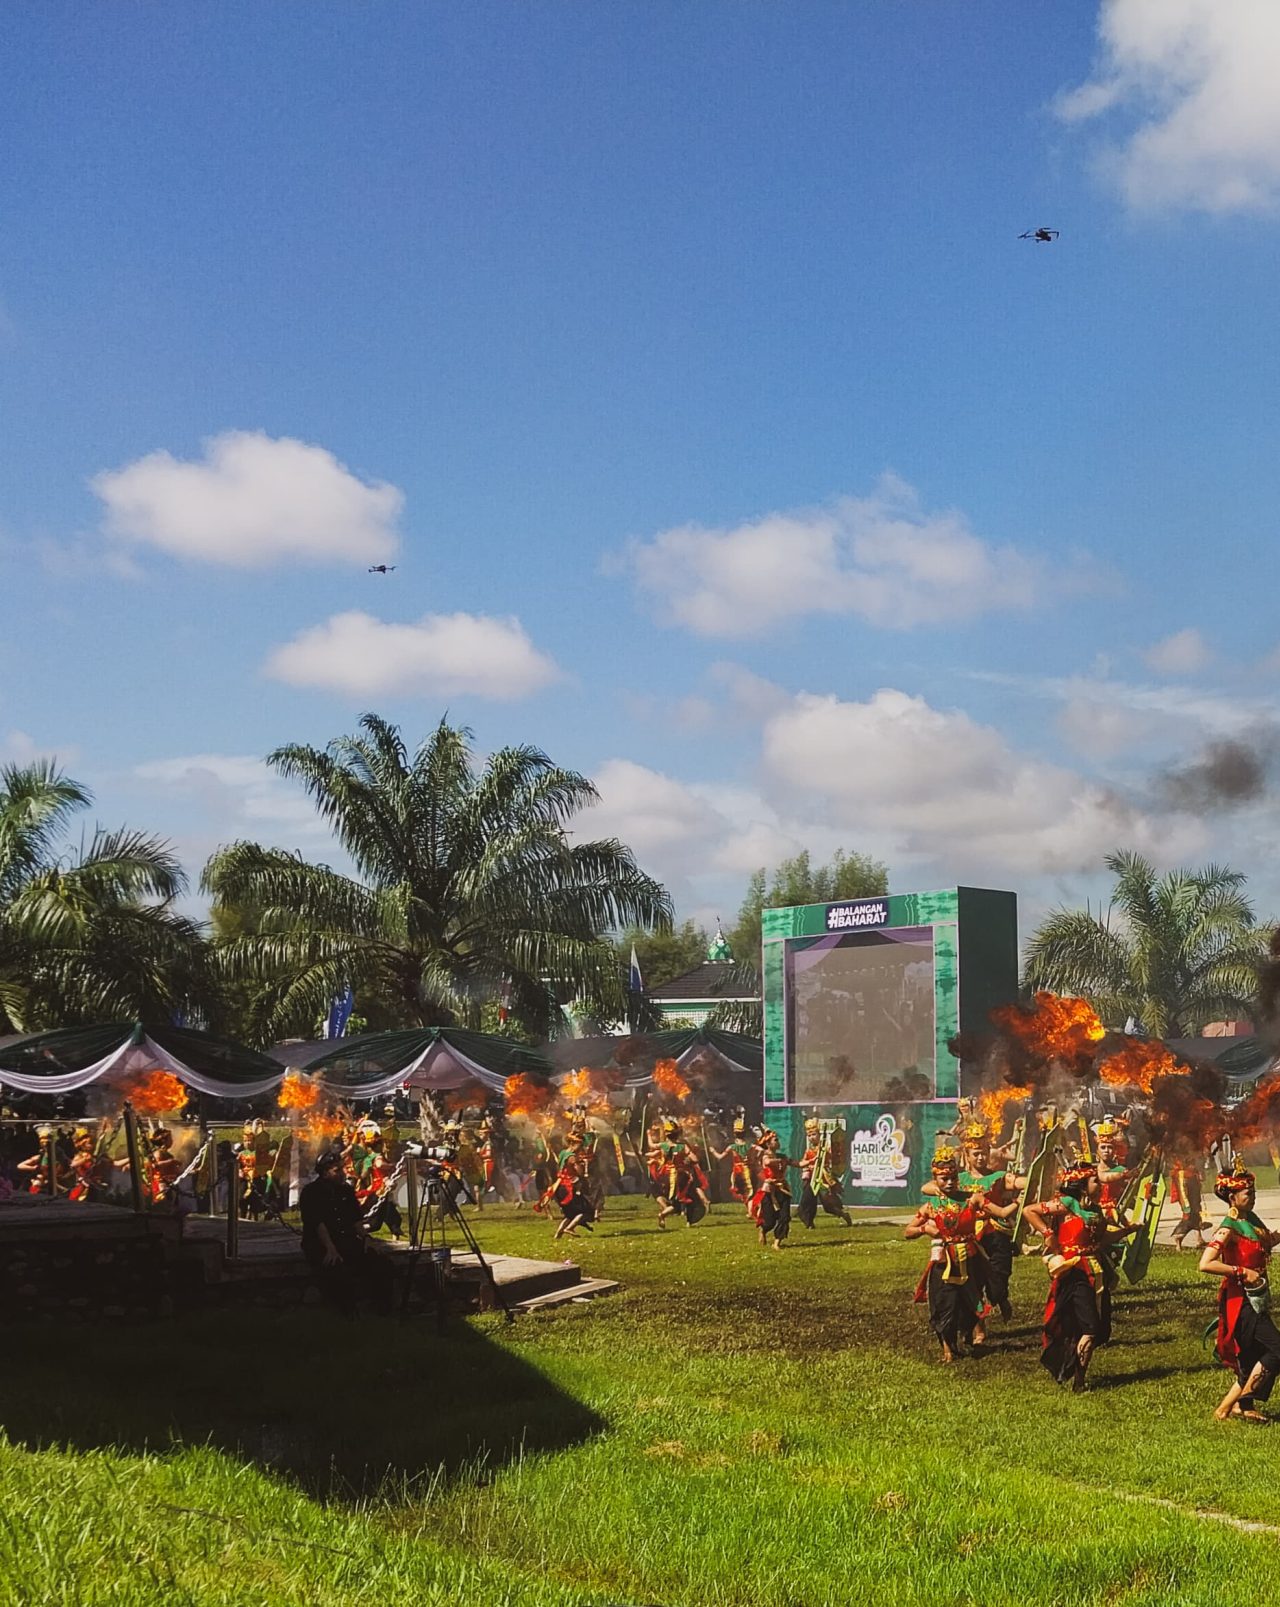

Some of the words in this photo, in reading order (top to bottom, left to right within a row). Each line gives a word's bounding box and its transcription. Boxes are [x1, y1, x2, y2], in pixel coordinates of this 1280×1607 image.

[837, 911, 887, 928] BAHARAT
[853, 1143, 879, 1154] HARI
[852, 1154, 879, 1166] JADI
